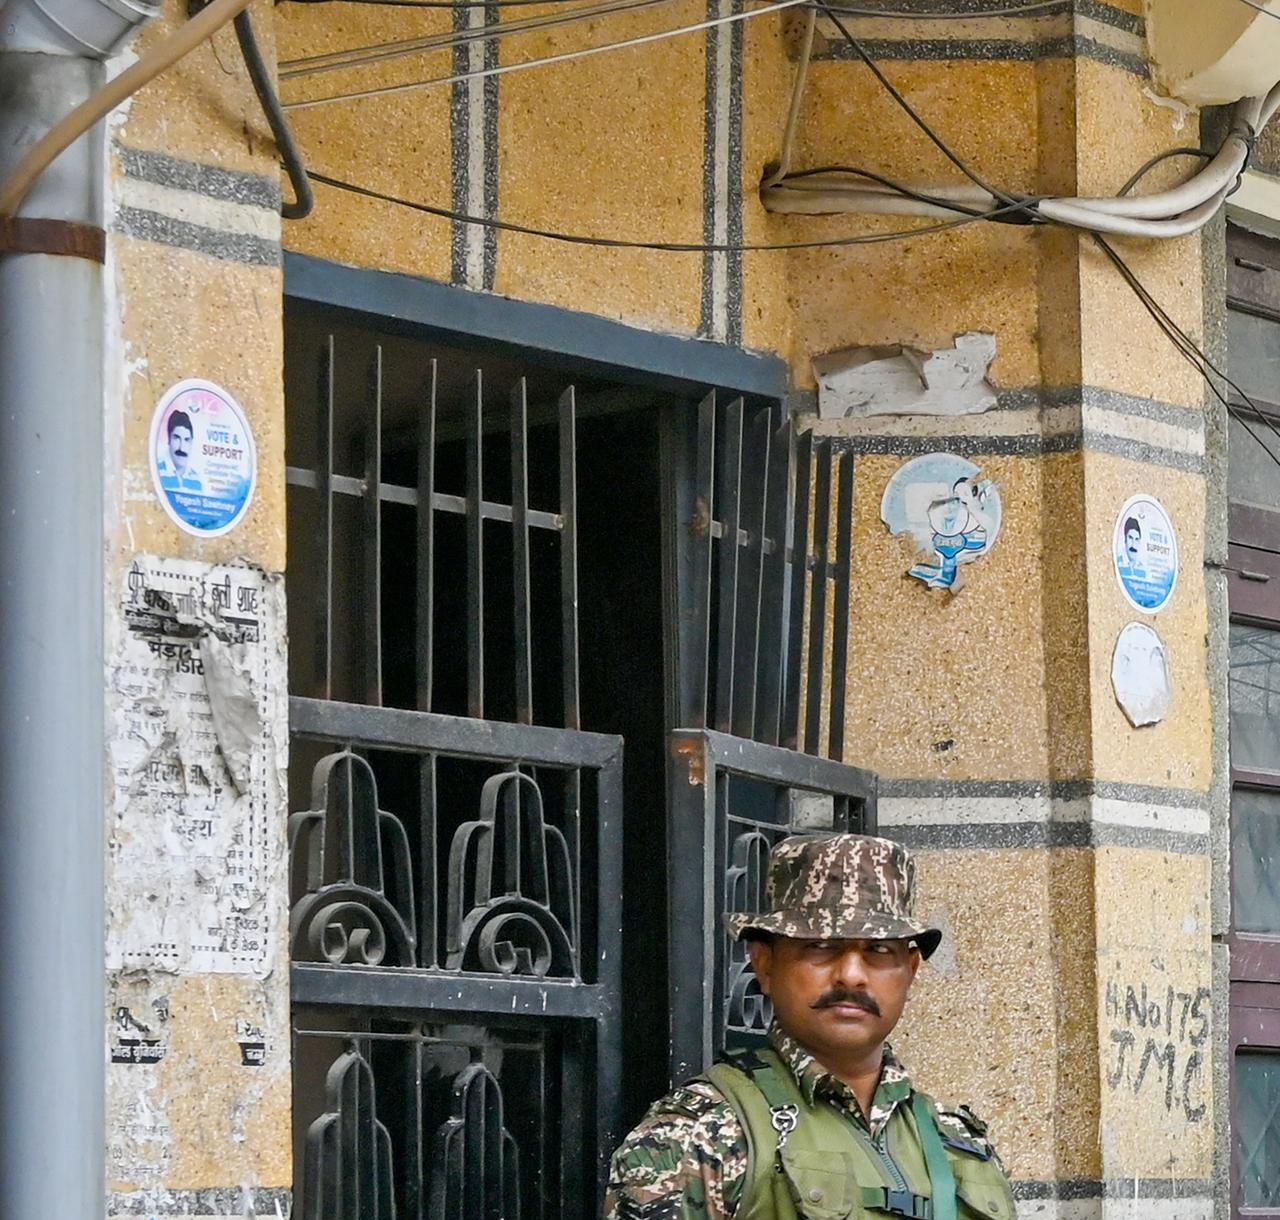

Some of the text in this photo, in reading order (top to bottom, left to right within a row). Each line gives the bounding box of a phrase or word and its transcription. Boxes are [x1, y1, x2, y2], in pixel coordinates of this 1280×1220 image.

[207, 429, 239, 445] VOTE &
[202, 444, 243, 461] SUPPORT
[1146, 543, 1170, 555] SUPPORT
